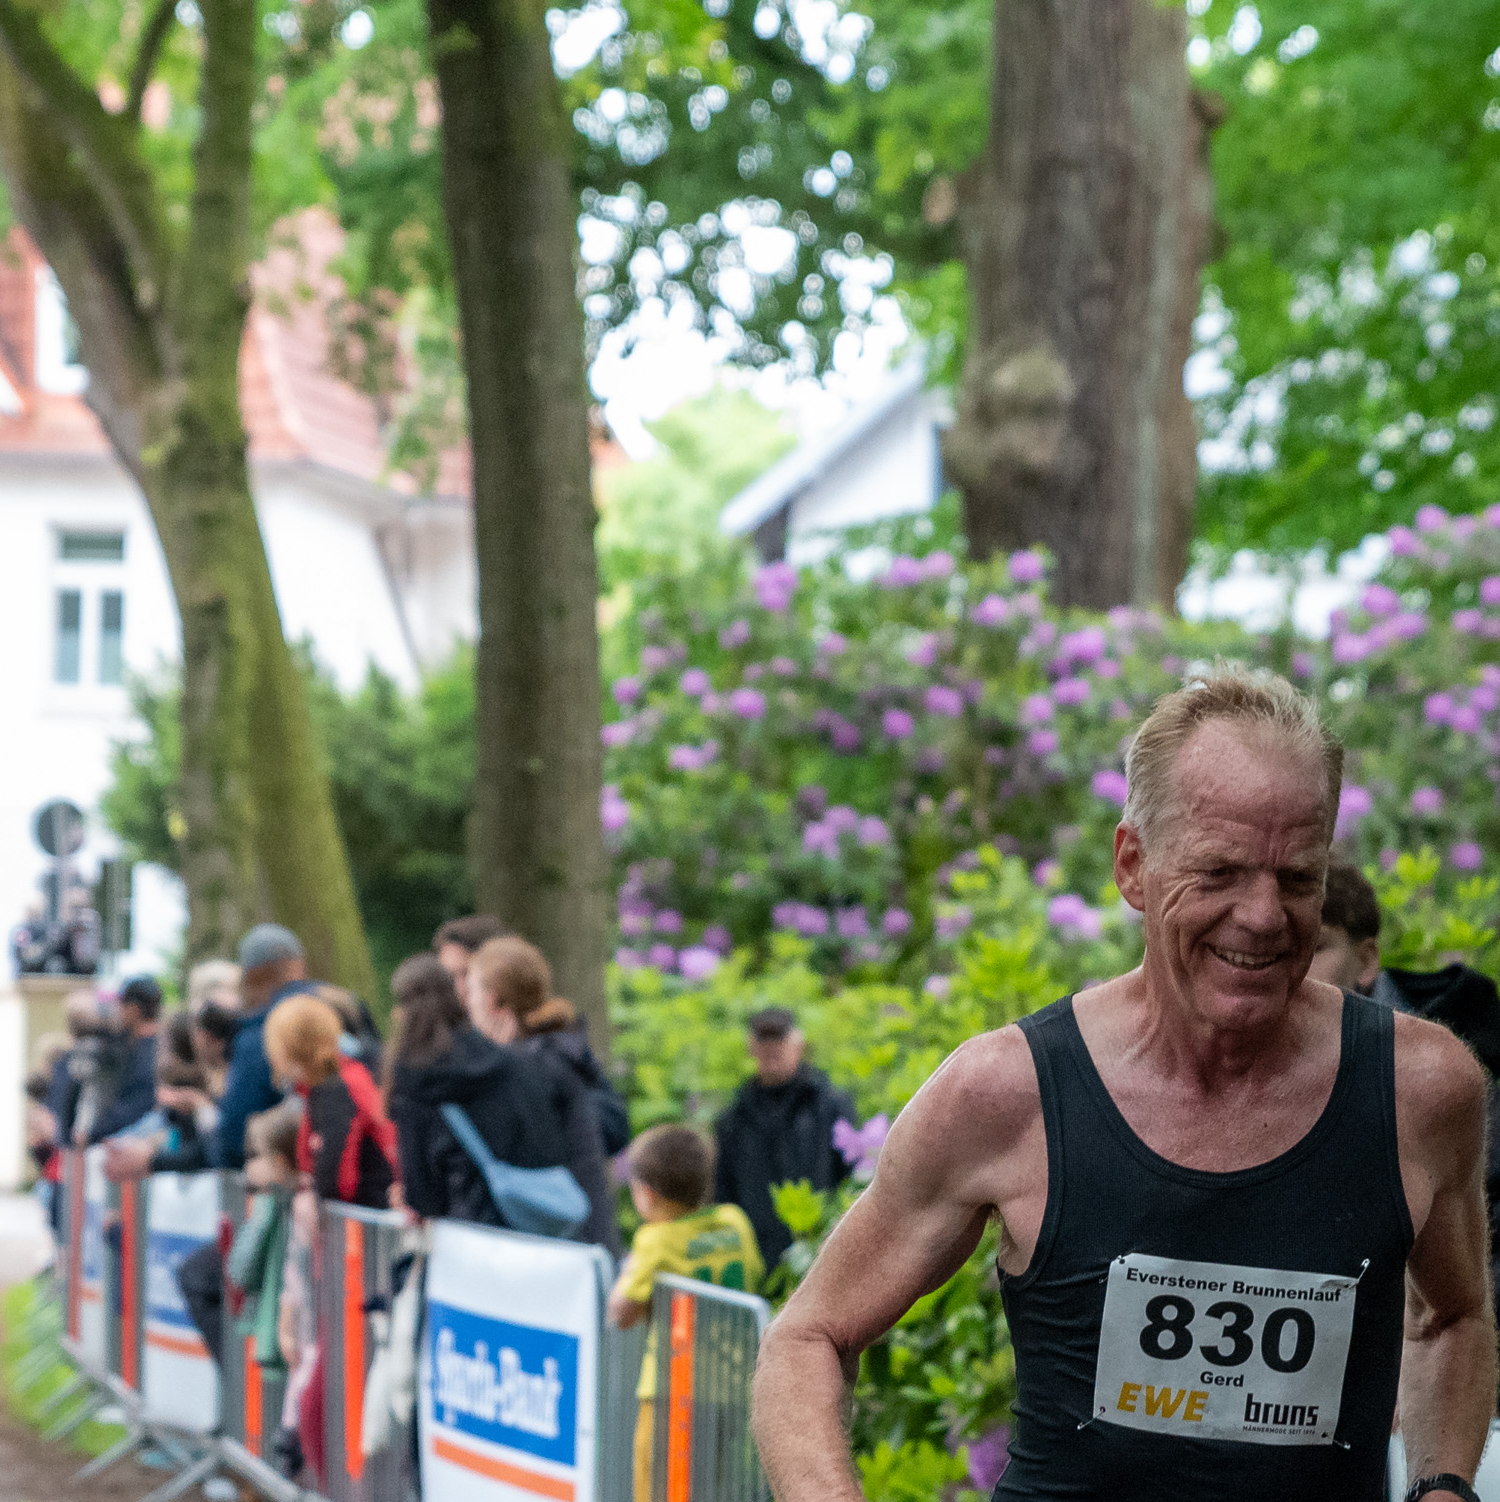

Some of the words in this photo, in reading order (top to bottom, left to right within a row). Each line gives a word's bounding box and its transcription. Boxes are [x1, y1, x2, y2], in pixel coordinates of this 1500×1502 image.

[1126, 1267, 1227, 1292] Everstener
[1232, 1280, 1342, 1302] Brunnenlauf
[1139, 1294, 1316, 1374] 830
[1200, 1370, 1245, 1388] Gerd
[1116, 1381, 1210, 1422] EWE
[1244, 1392, 1320, 1427] bruns
